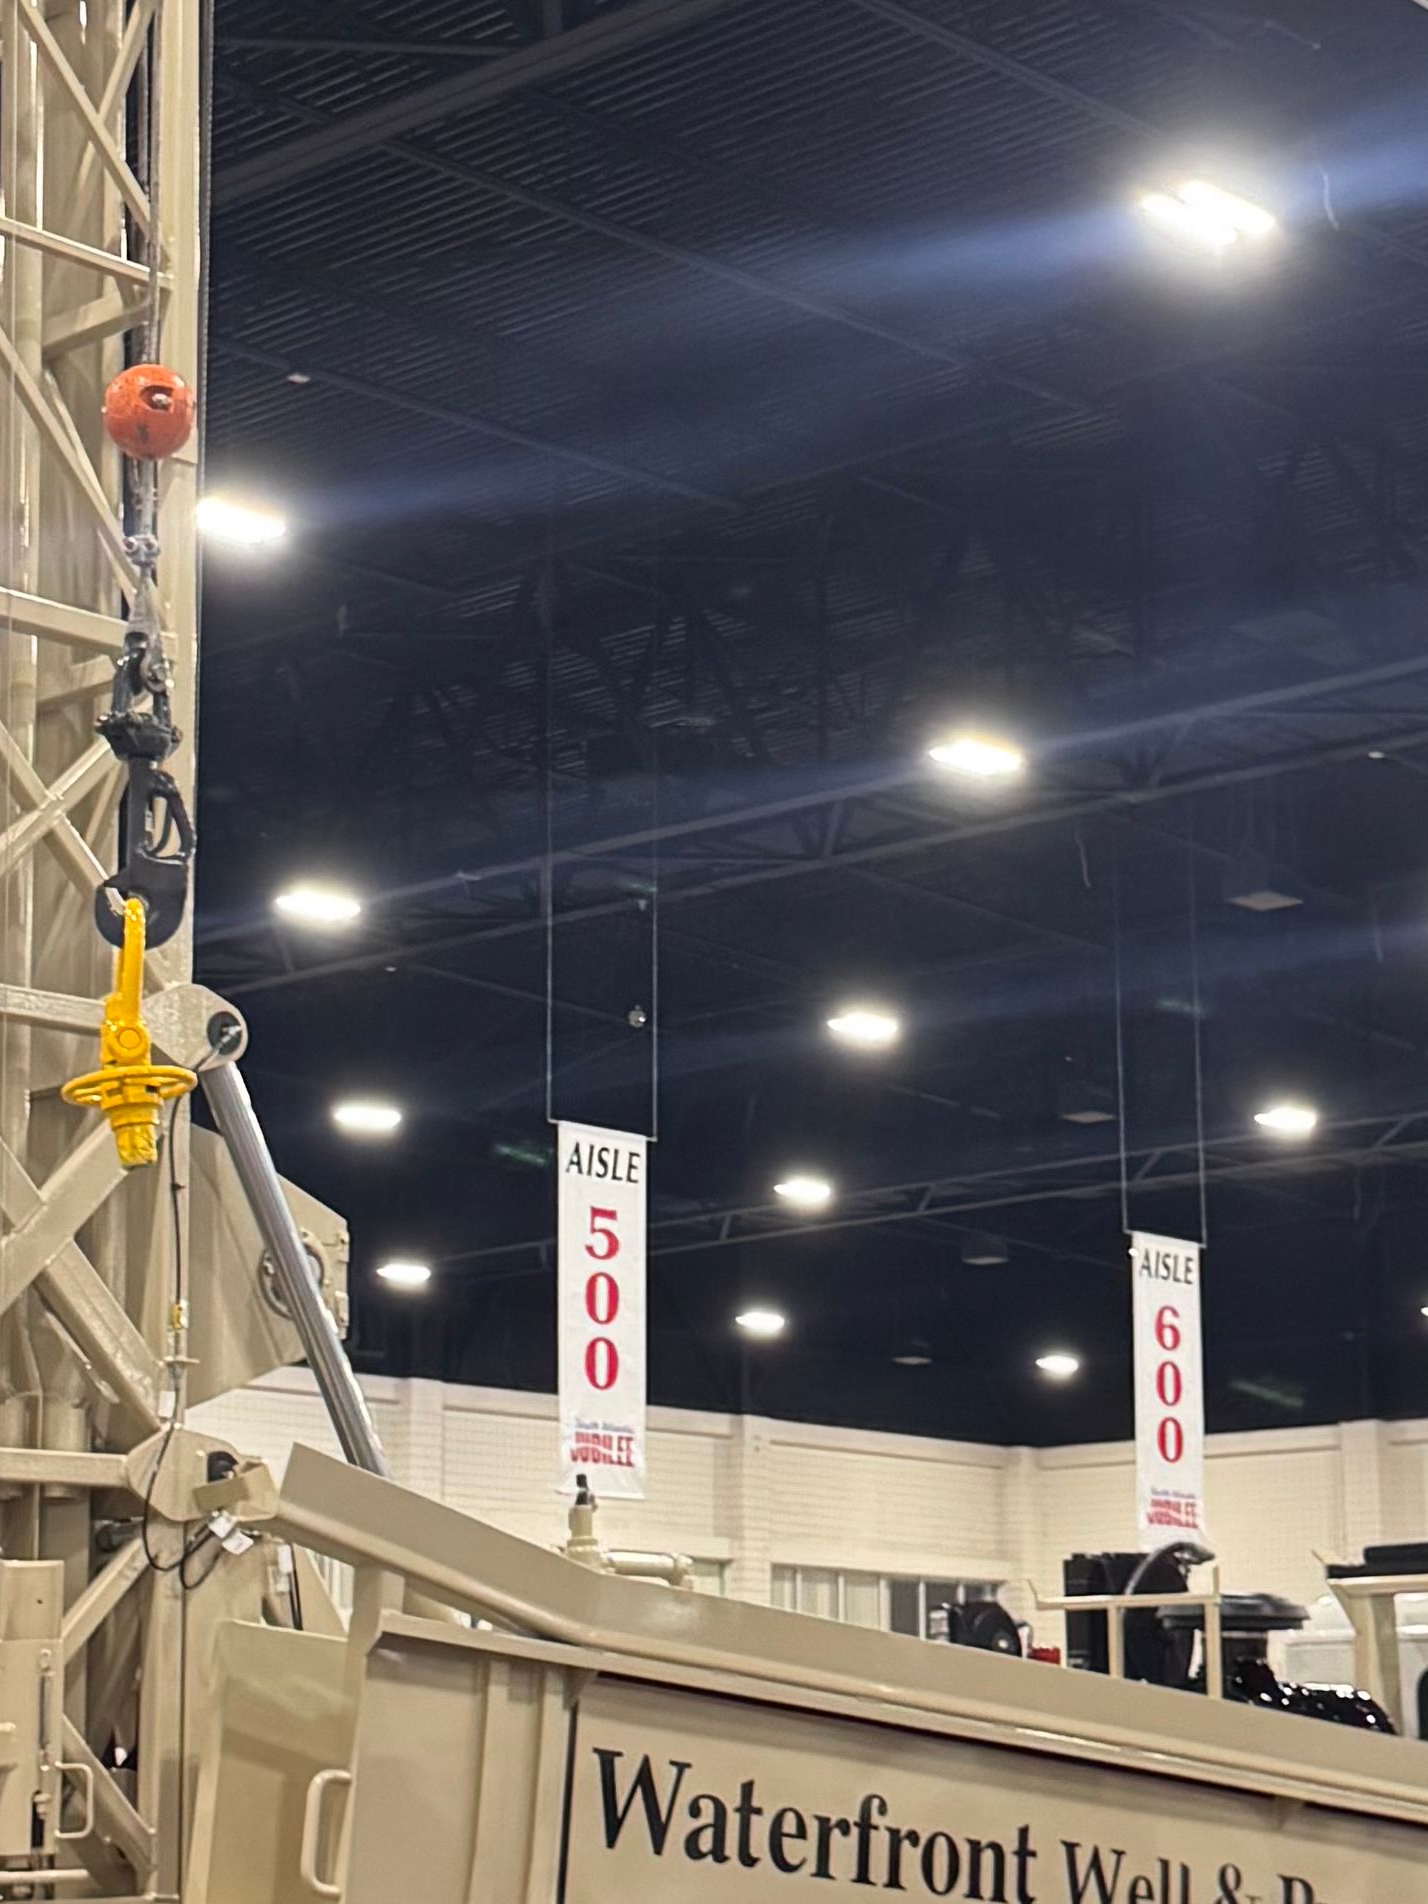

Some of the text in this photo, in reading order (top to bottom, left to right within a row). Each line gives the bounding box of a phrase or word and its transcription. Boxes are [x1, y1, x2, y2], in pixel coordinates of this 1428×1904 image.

[565, 1141, 641, 1184] AISLE
[585, 1205, 619, 1390] 500
[1139, 1248, 1194, 1285] AISLE
[1154, 1304, 1184, 1463] 600
